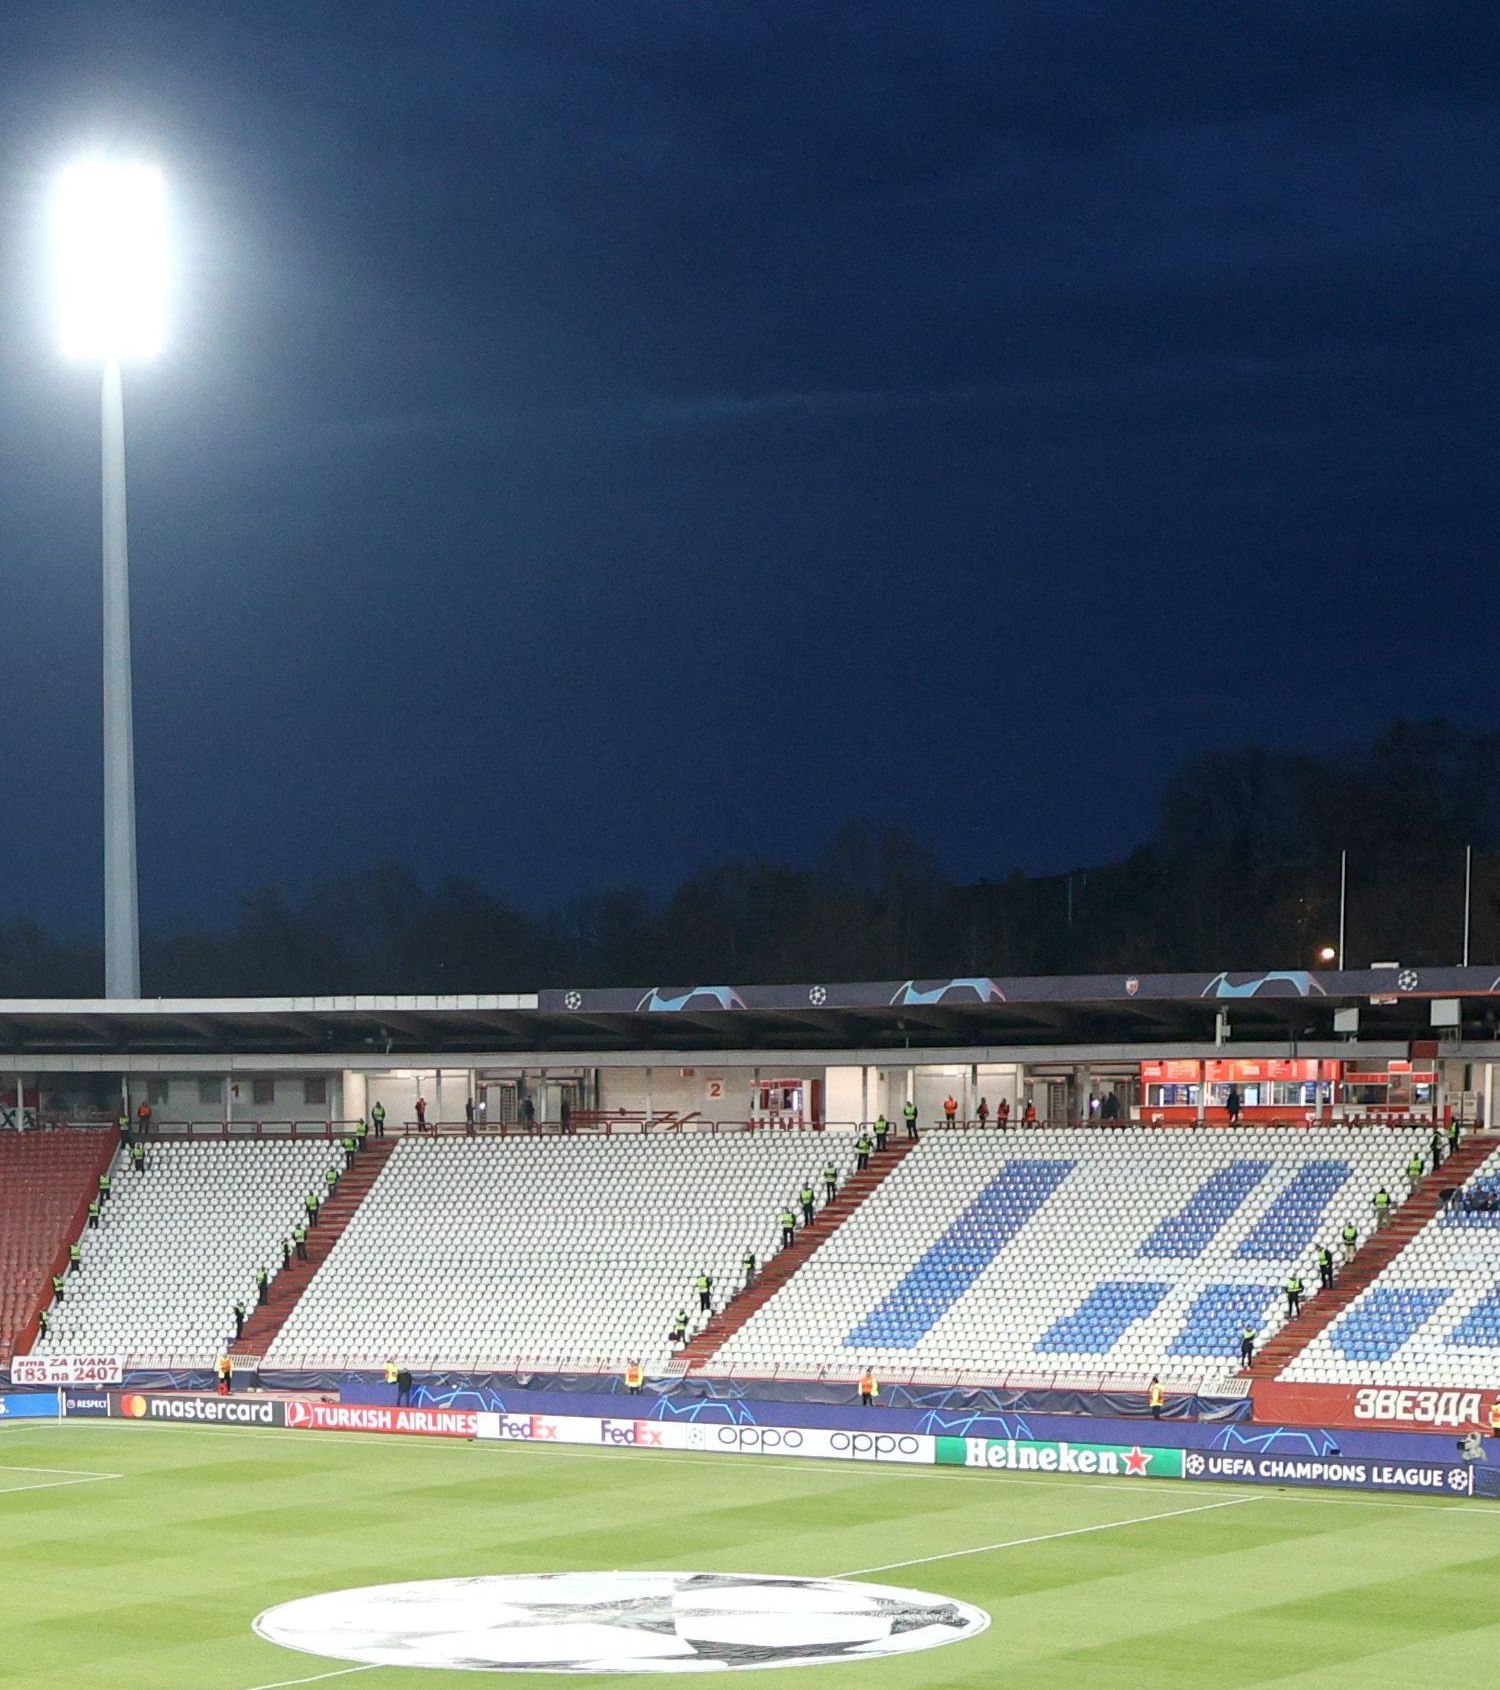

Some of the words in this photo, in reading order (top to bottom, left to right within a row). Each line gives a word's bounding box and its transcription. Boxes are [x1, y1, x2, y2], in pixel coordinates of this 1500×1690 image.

[710, 1083, 721, 1097] 2
[13, 1367, 47, 1382] 183
[51, 1370, 70, 1381] na
[73, 1366, 121, 1382] 2407
[49, 1358, 69, 1367] ZA
[73, 1358, 117, 1367] IVANA
[151, 1397, 274, 1423] mastercard
[314, 1406, 392, 1431] TURKISH
[398, 1409, 478, 1434] AIRLINES
[1353, 1387, 1482, 1427] ЗВЕЗДА
[498, 1414, 558, 1440] FedEx
[601, 1419, 663, 1445] FedEx
[717, 1425, 804, 1452] oppo
[829, 1431, 919, 1458] oppo
[965, 1437, 1120, 1475] Heineken
[1207, 1457, 1257, 1476] UEFA
[1259, 1460, 1368, 1482] CHAMPIONS
[1371, 1466, 1444, 1488] LEAGUE
